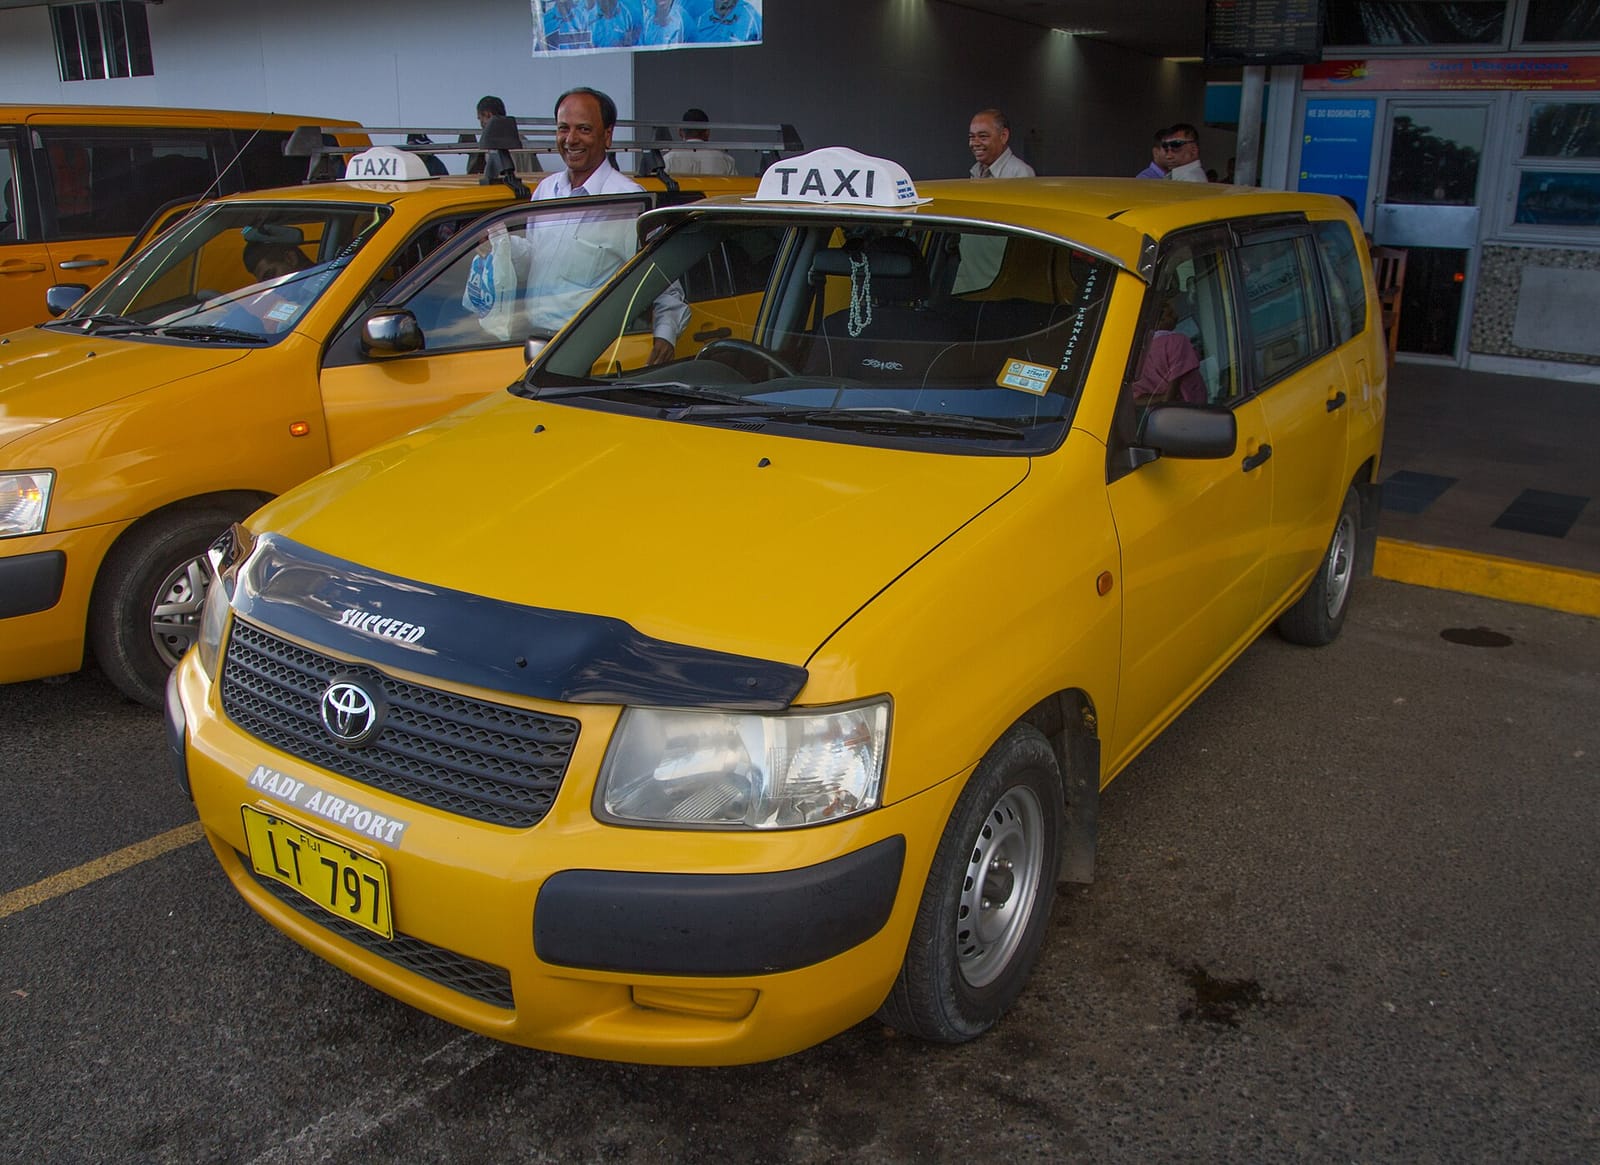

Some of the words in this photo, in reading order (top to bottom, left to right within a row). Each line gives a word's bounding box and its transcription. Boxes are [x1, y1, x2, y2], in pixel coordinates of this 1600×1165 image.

[353, 158, 397, 177] TAXI
[774, 167, 876, 199] TAXI
[338, 608, 426, 643] SUCCEED
[250, 766, 305, 803] NADI
[307, 790, 402, 842] AIRPORT
[300, 835, 321, 854] FIJI
[267, 830, 302, 886] LT
[320, 856, 380, 925] 797
